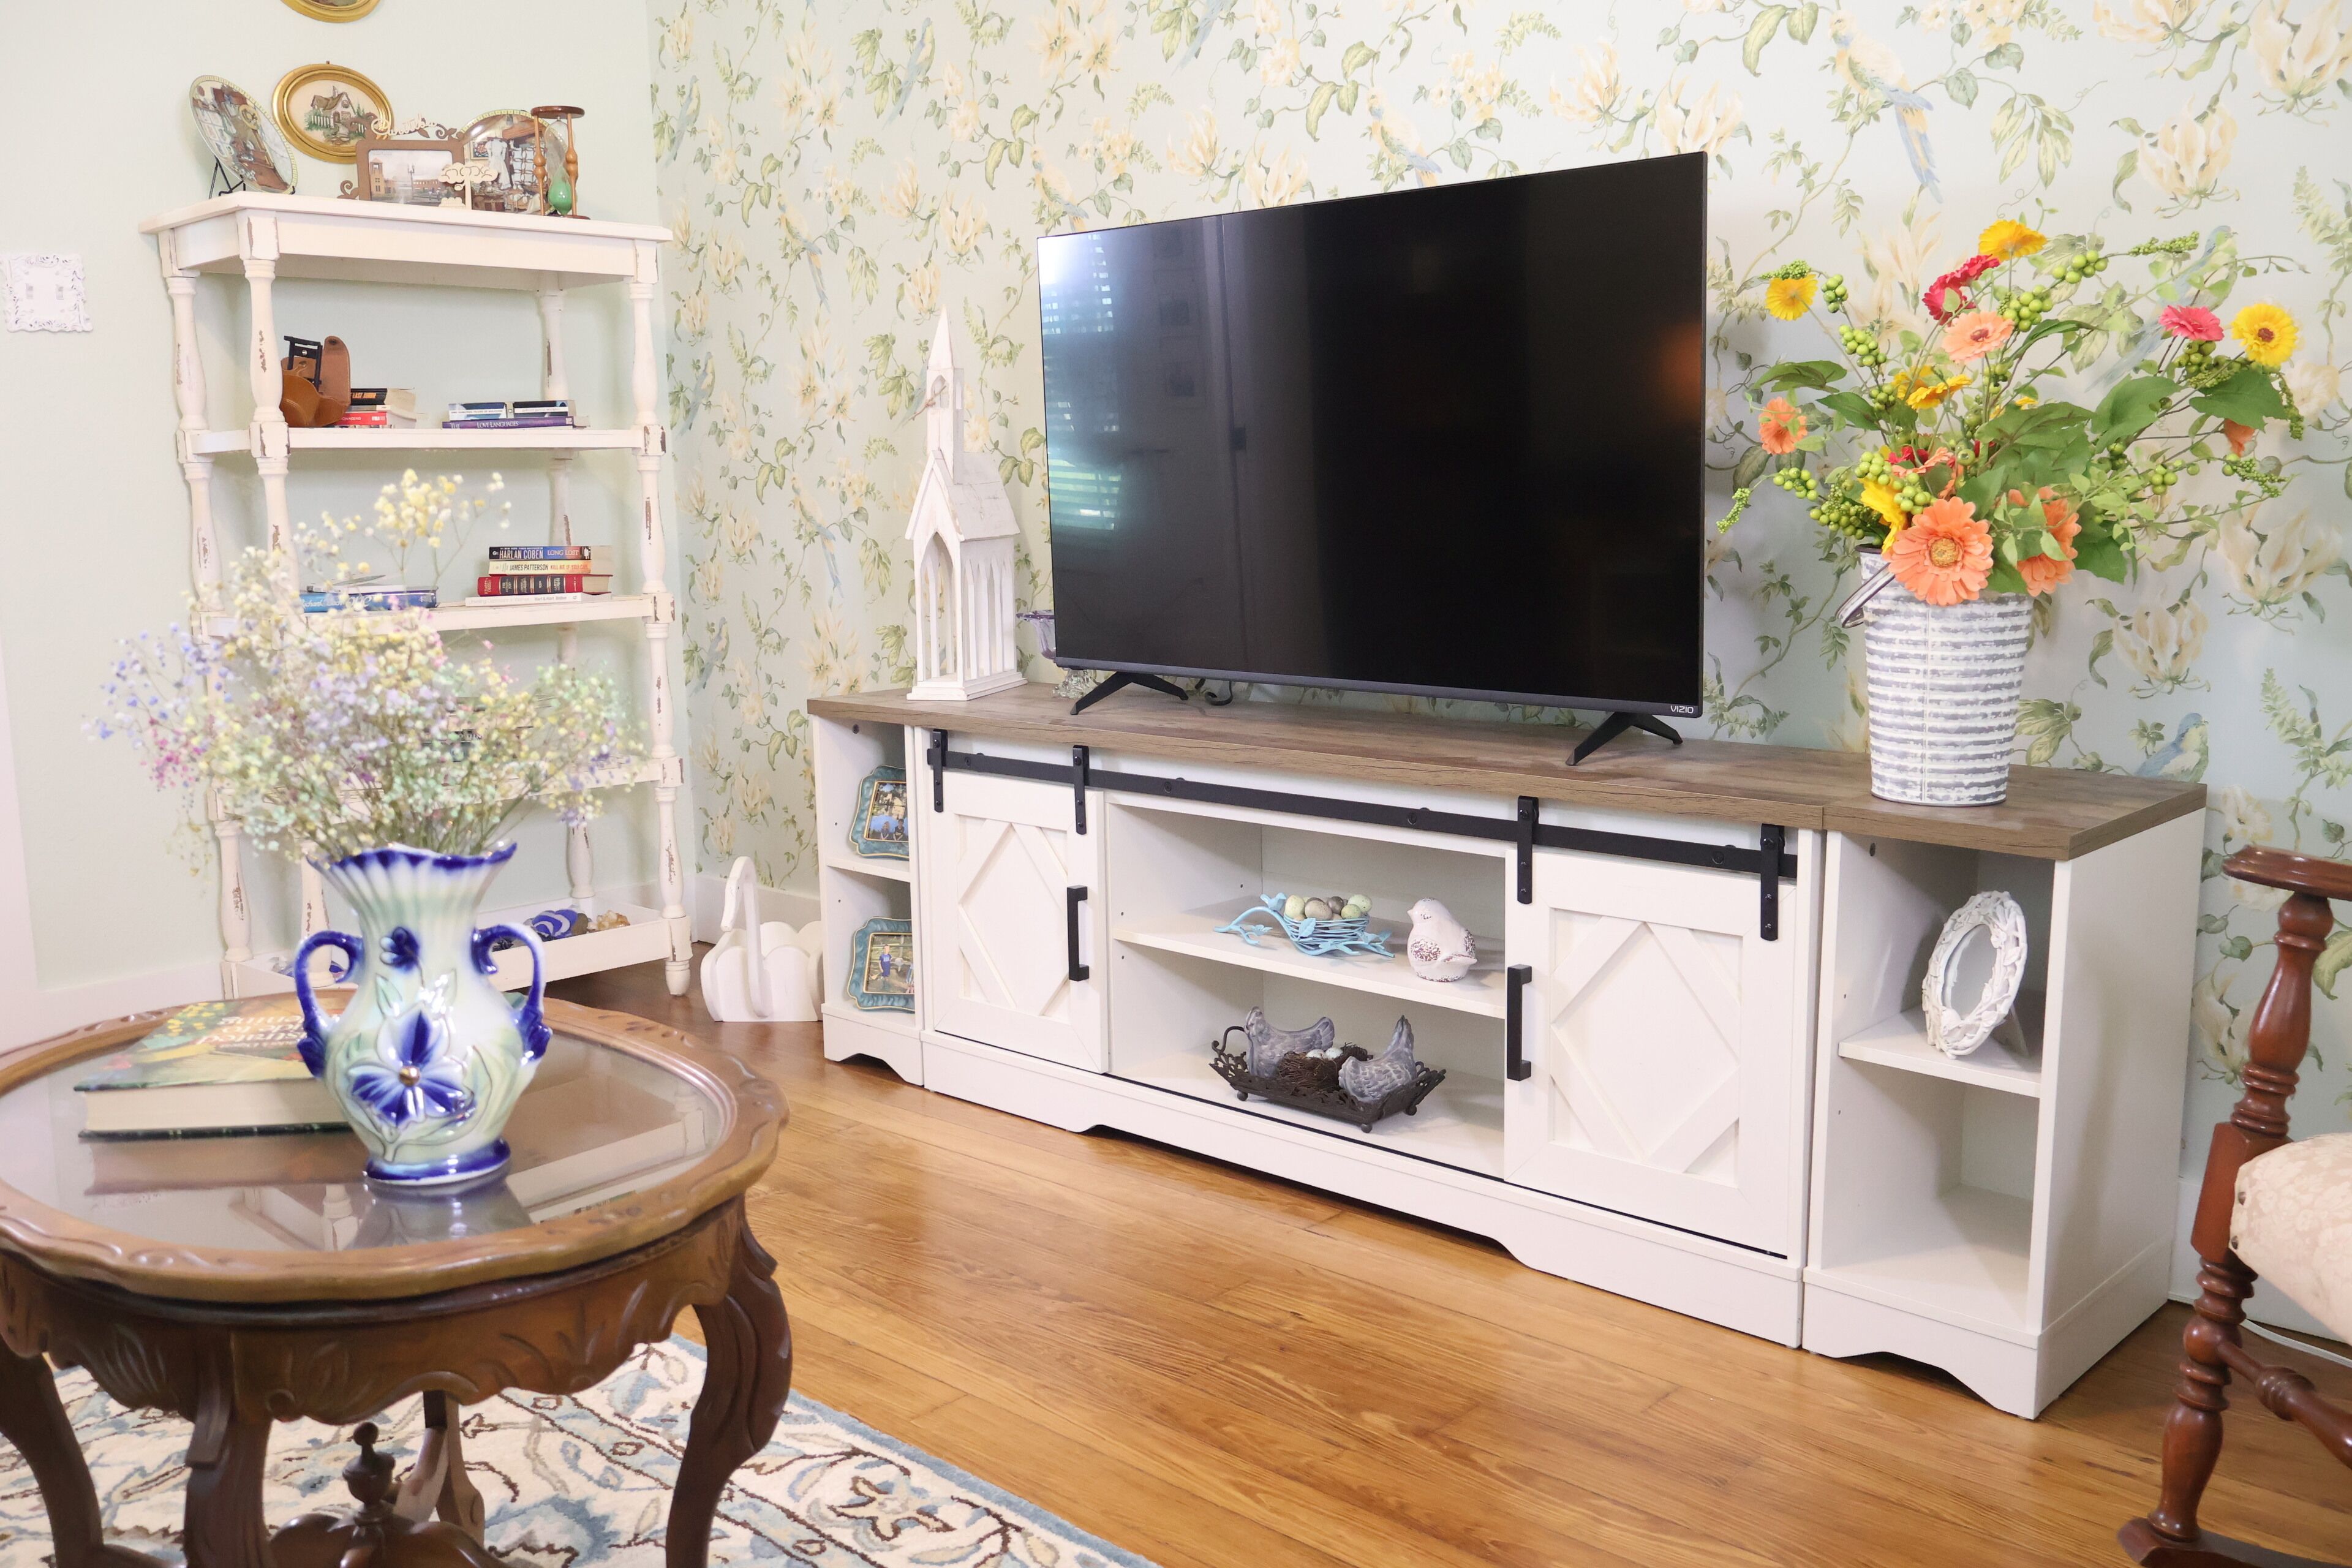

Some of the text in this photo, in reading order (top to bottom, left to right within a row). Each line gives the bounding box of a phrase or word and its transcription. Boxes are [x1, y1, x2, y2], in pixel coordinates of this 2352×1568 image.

[499, 549, 543, 559] HARLAN COBEN
[1670, 705, 1694, 714] VIZIO
